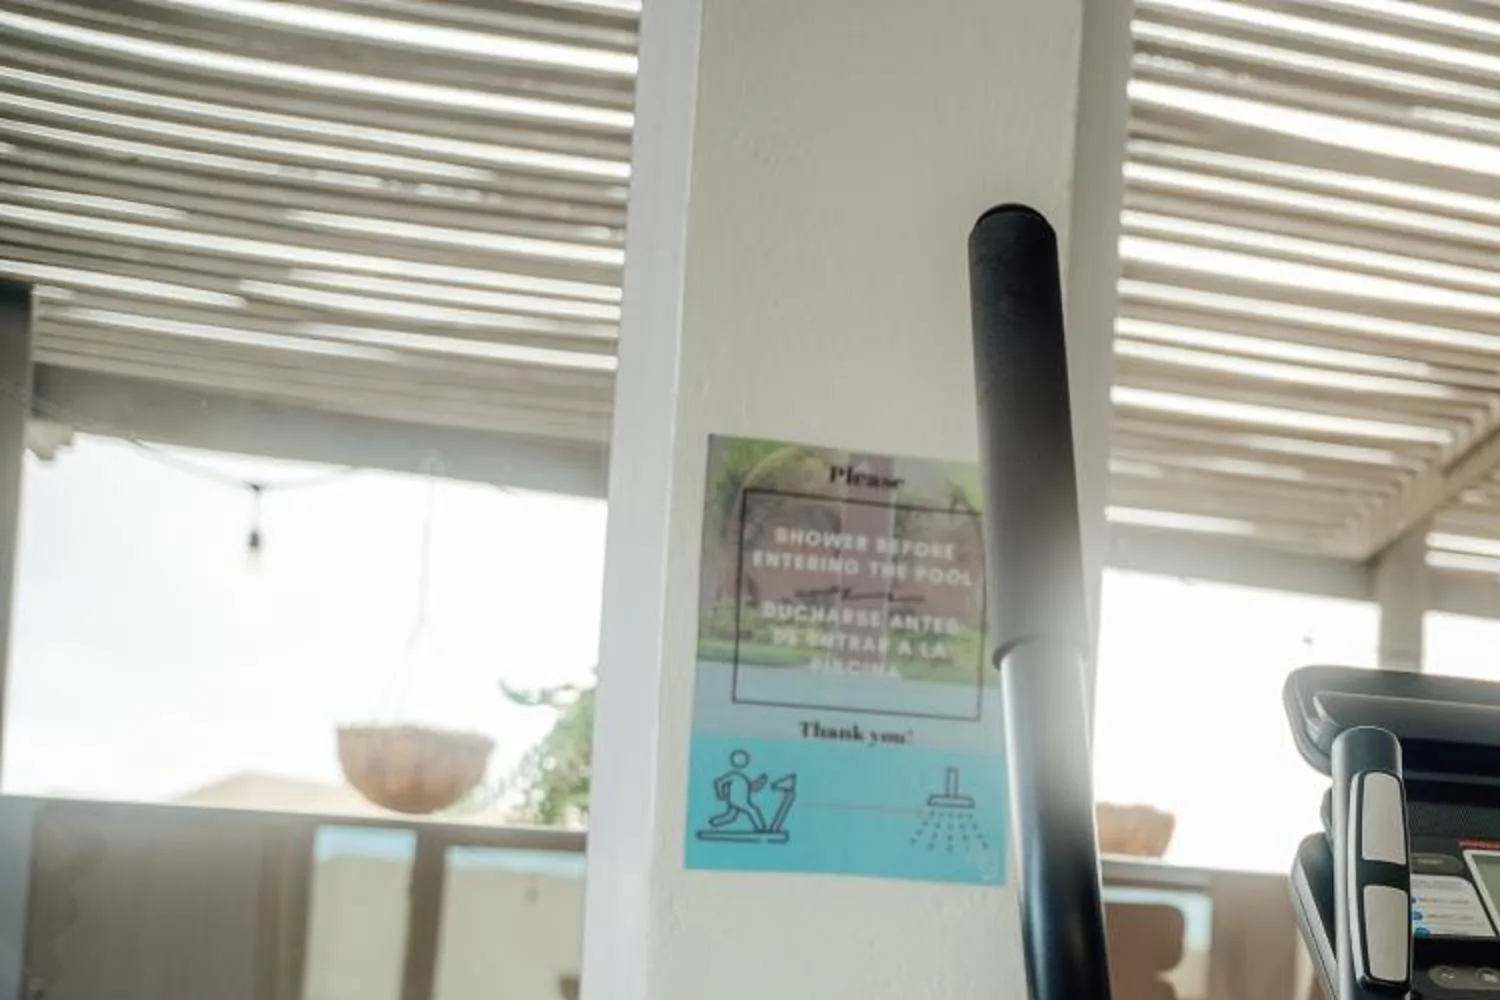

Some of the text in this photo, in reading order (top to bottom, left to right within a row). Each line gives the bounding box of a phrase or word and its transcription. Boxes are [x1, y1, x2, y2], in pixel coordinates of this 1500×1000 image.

[829, 465, 905, 488] Please
[774, 527, 957, 561] SHOWER BEFORE
[752, 550, 972, 587] ENTERING THE POOL
[762, 600, 960, 635] DUCHARSE ANTES
[898, 641, 913, 657] A
[921, 642, 948, 660] LA
[799, 720, 865, 742] Thank
